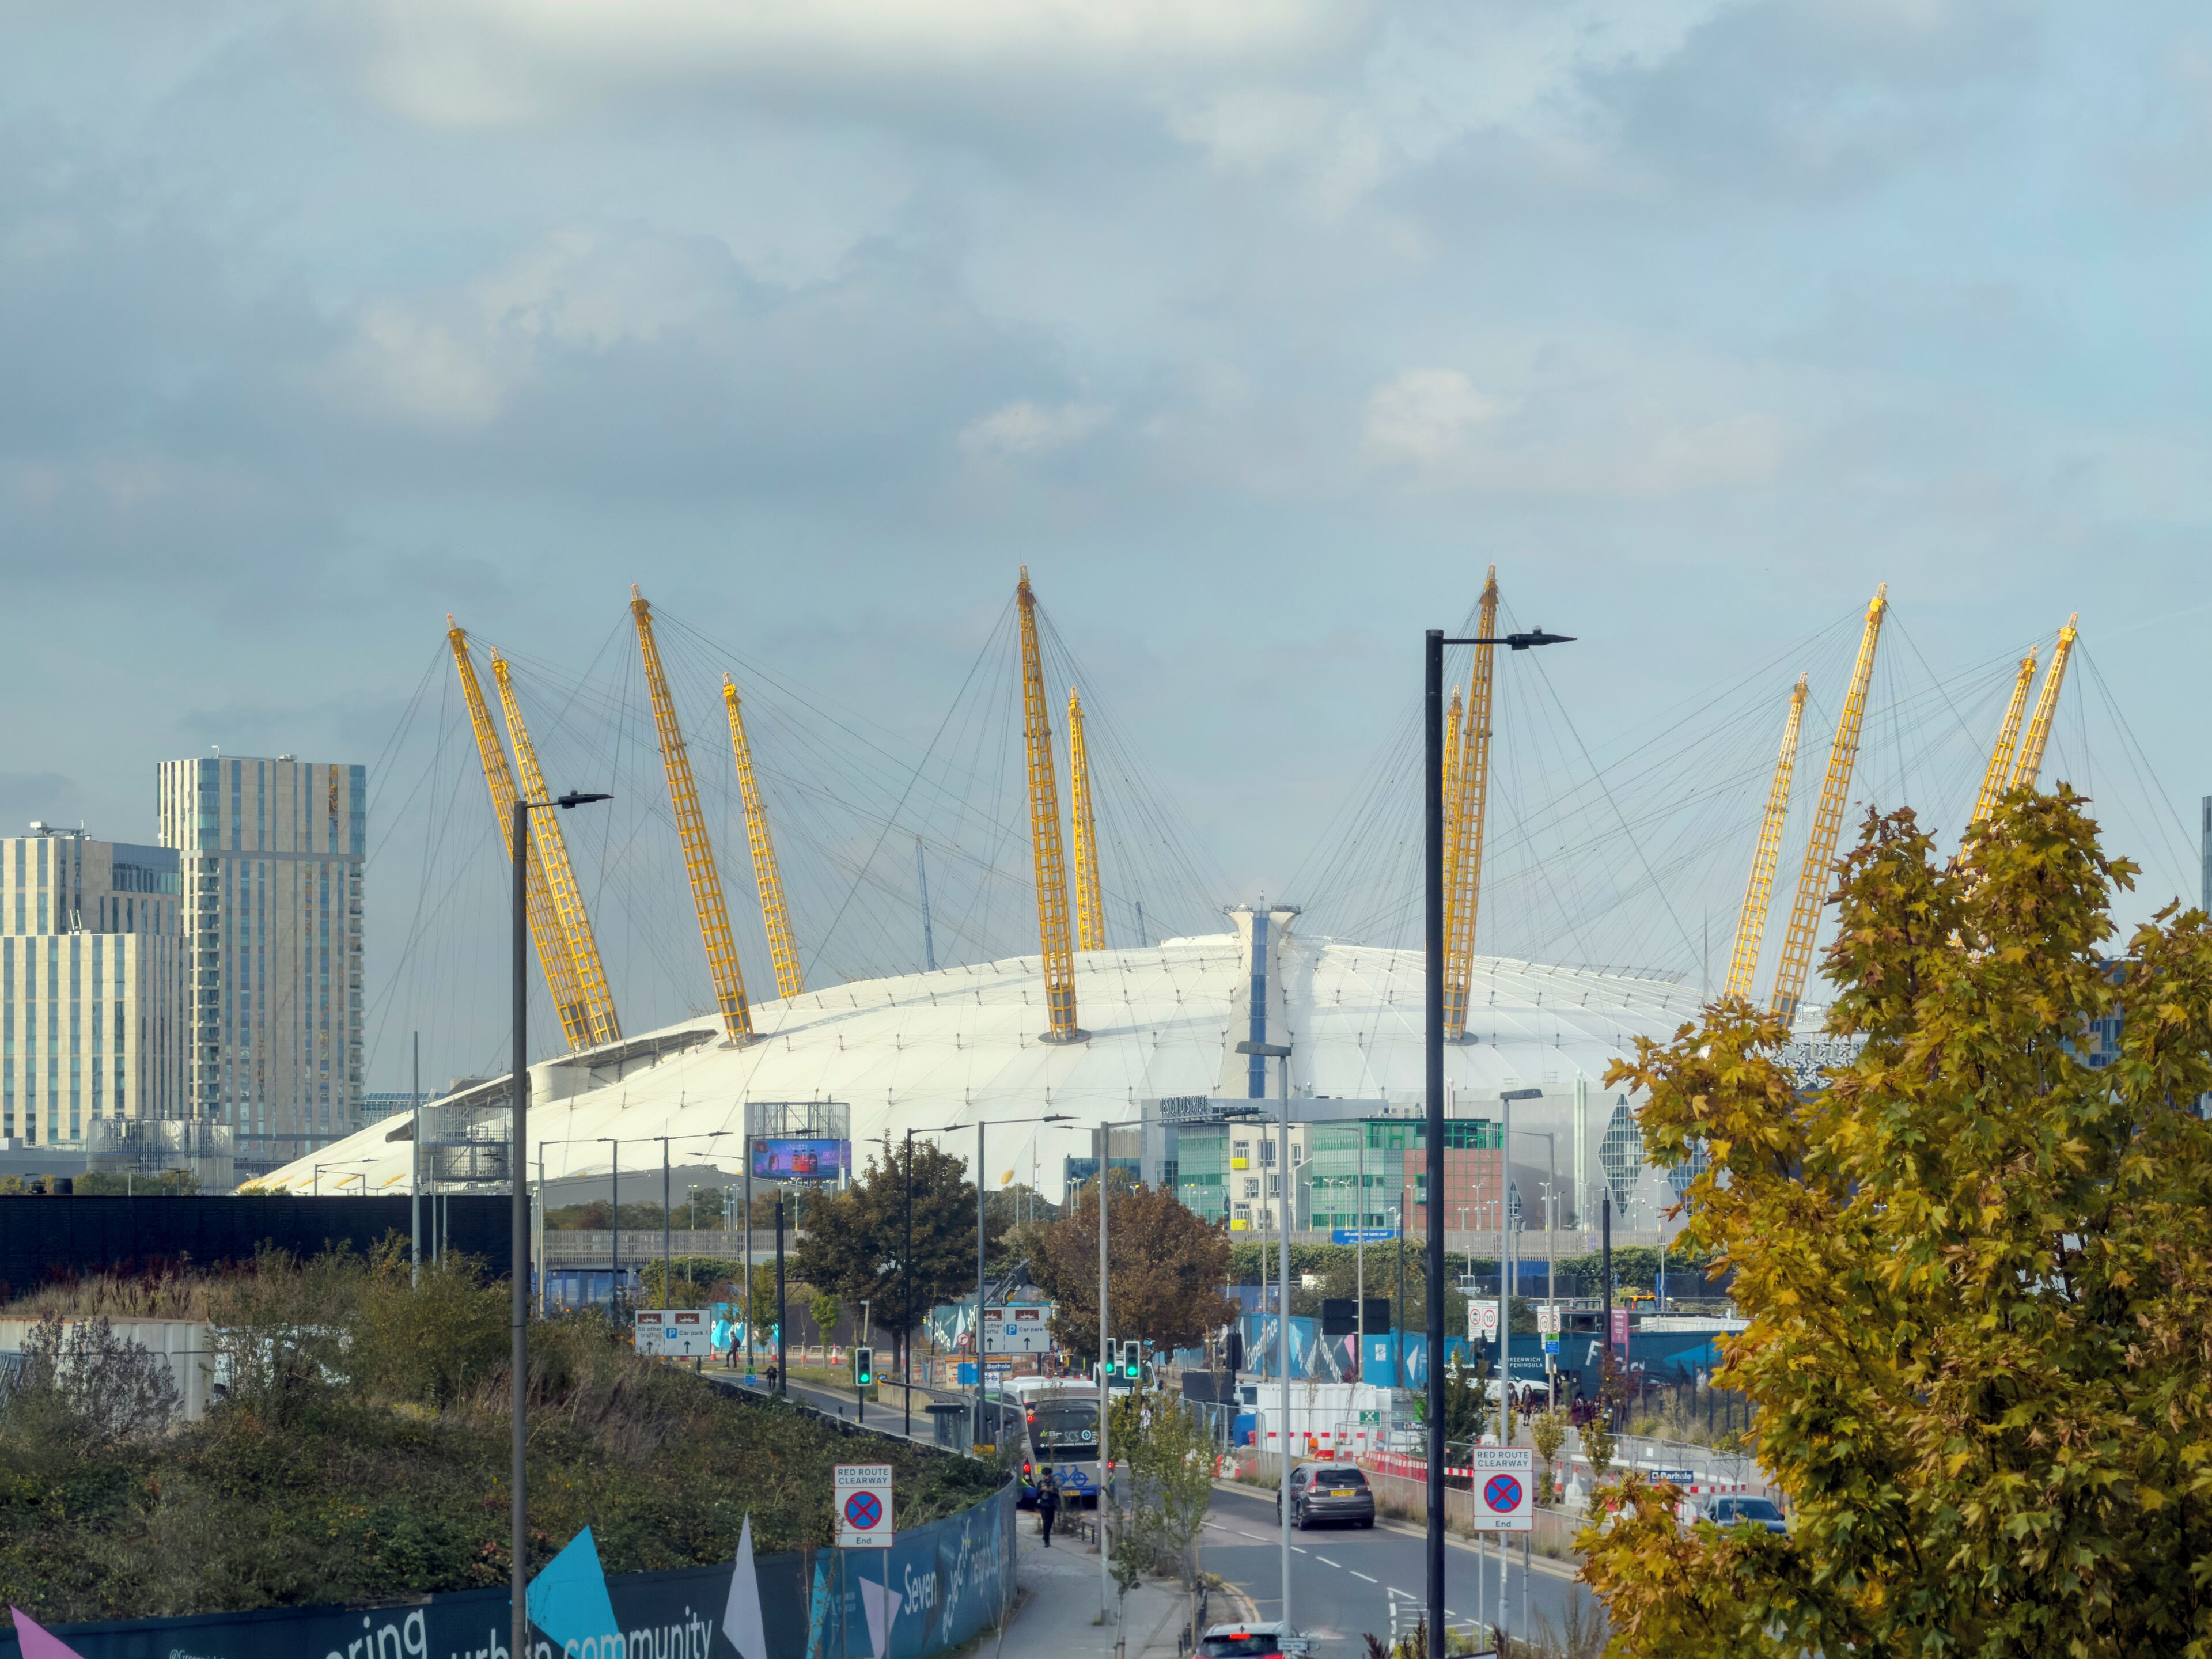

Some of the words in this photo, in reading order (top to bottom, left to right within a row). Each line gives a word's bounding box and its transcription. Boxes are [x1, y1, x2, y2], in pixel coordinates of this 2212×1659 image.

[1160, 1097, 1180, 1114] DESIGN
[1181, 1095, 1207, 1113] DISTRICT
[1486, 1315, 1493, 1323] 10
[904, 1562, 937, 1616] Seven
[563, 1605, 713, 1659] community
